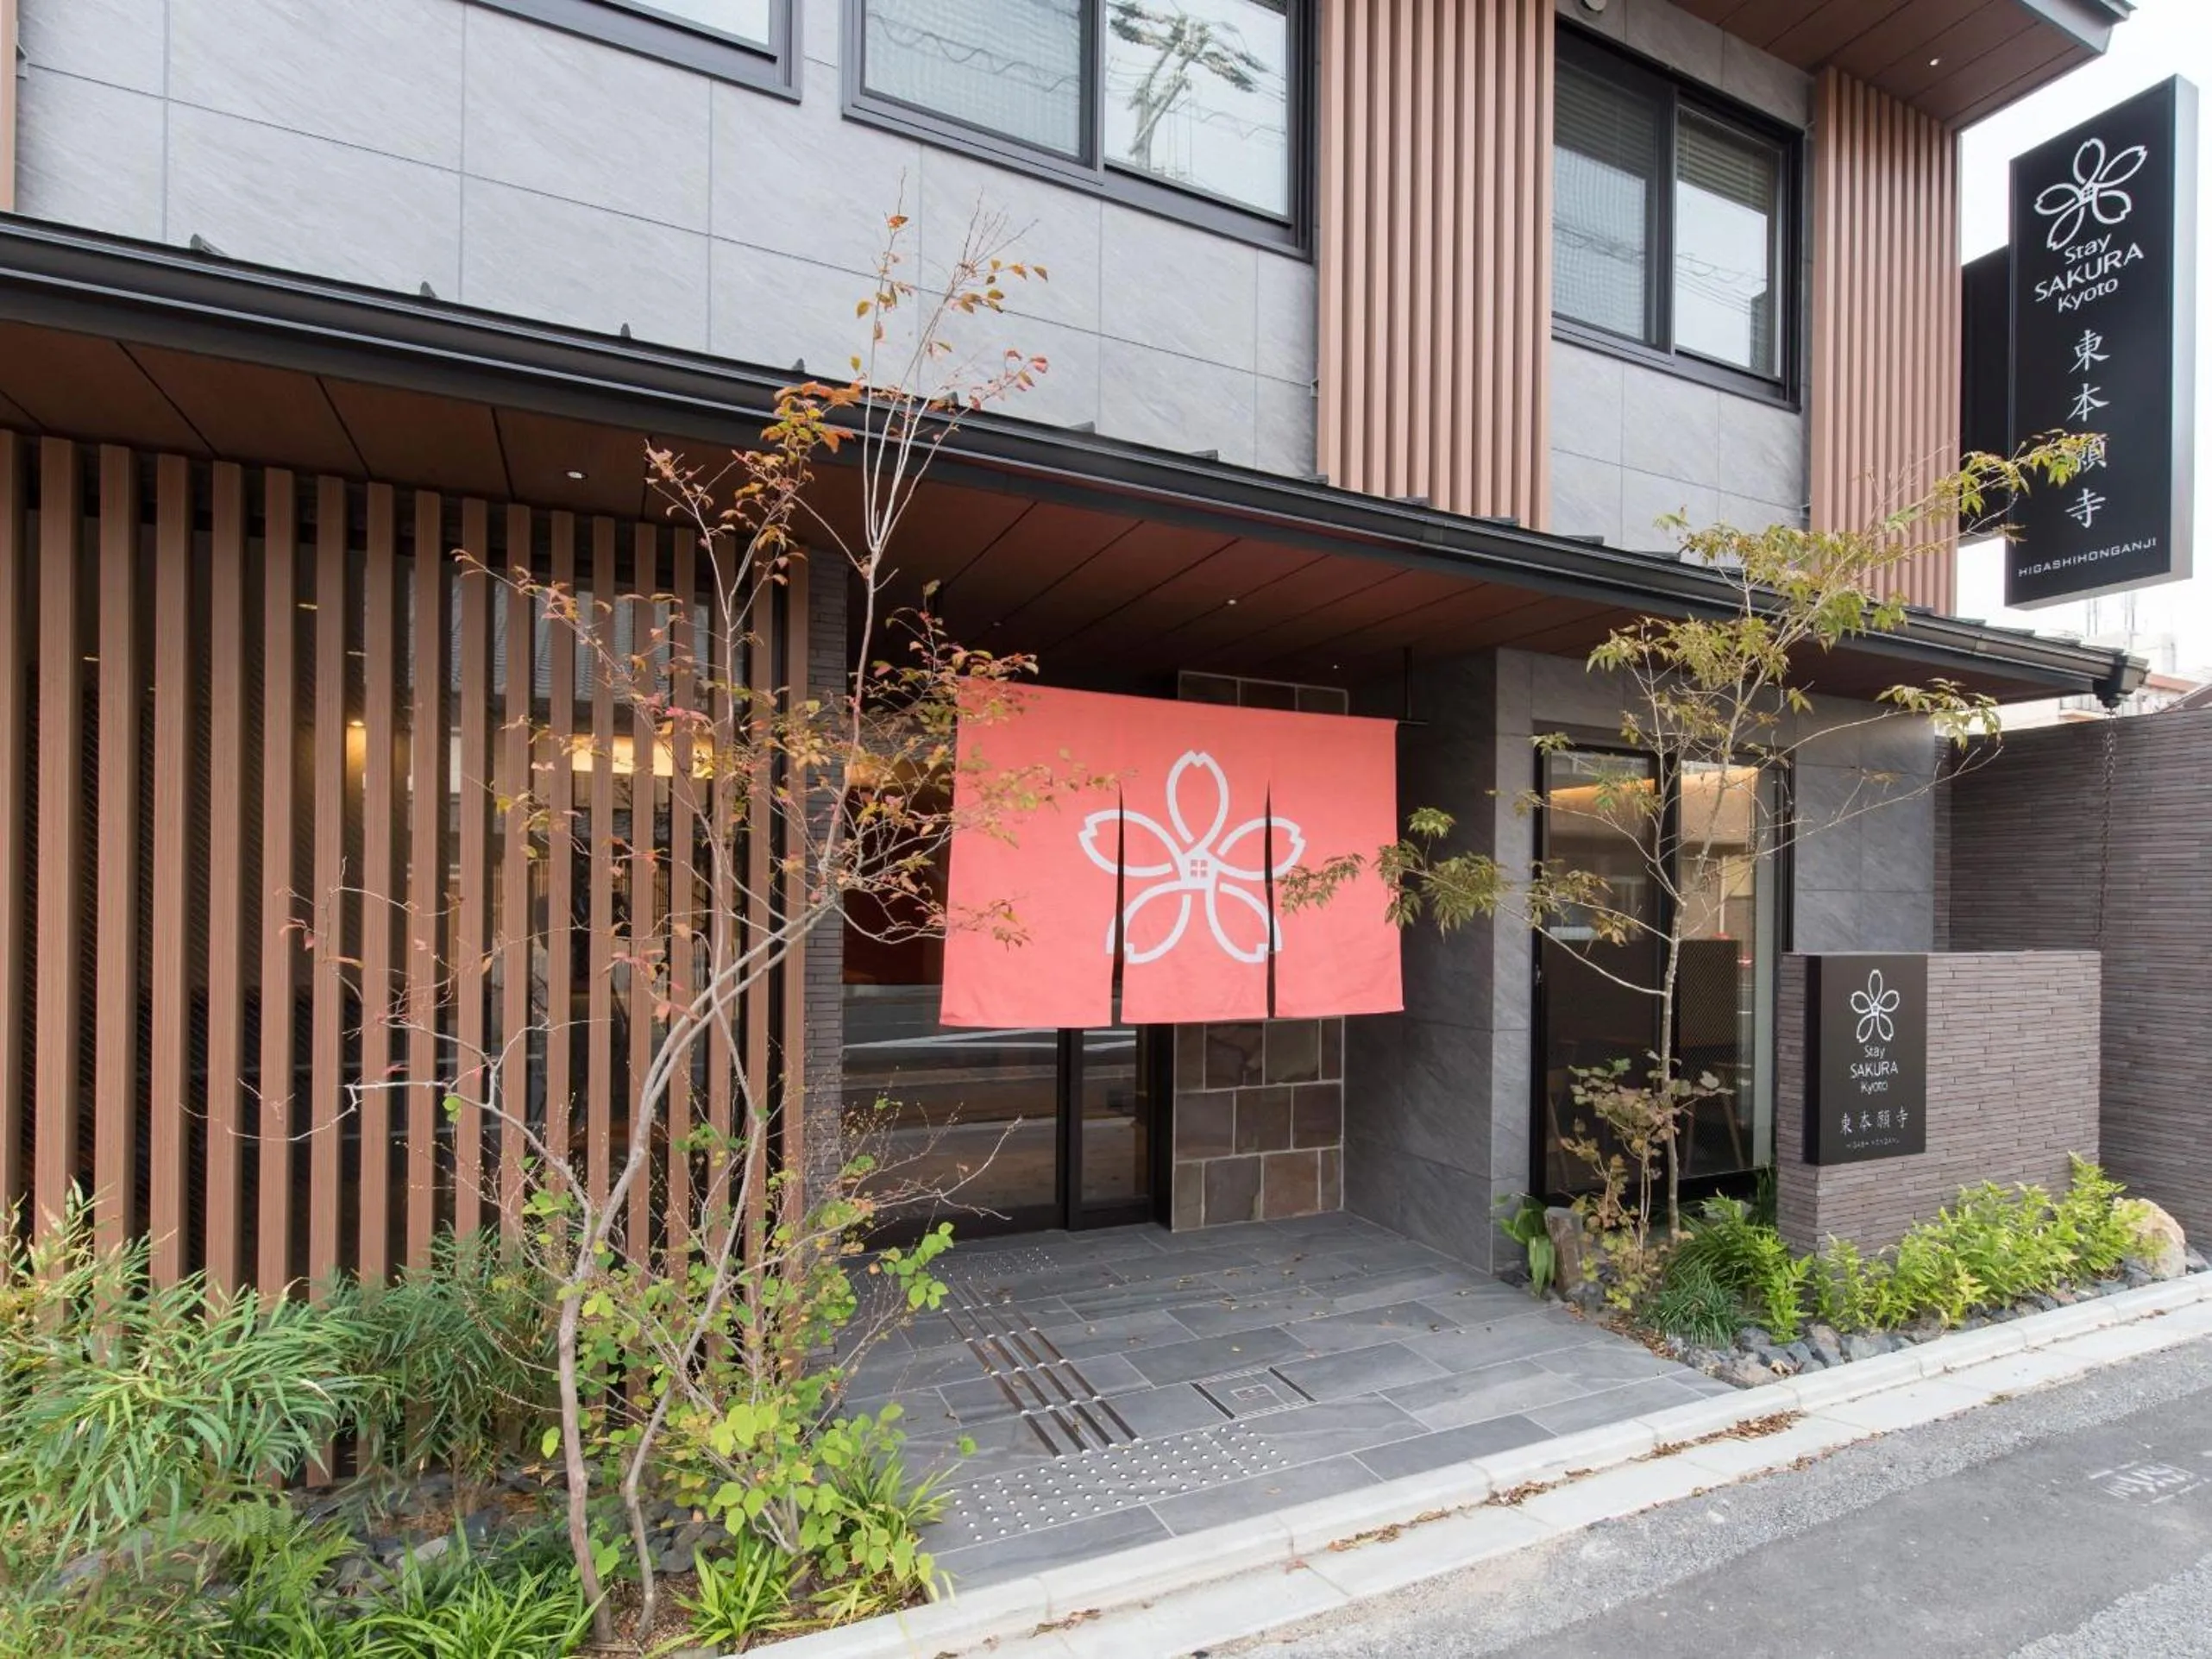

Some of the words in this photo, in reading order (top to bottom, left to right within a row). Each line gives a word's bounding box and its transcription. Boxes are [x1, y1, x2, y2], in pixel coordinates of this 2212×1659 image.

[2064, 233, 2112, 265] Stay
[2034, 242, 2145, 303] SAKURA
[2058, 278, 2119, 313] Kyoto
[2017, 537, 2158, 577] HIGASHIHONGANJI
[1864, 1045, 1885, 1059] Stay
[1850, 1060, 1899, 1078] SAKURA
[1839, 1105, 1909, 1136] 東本願寺
